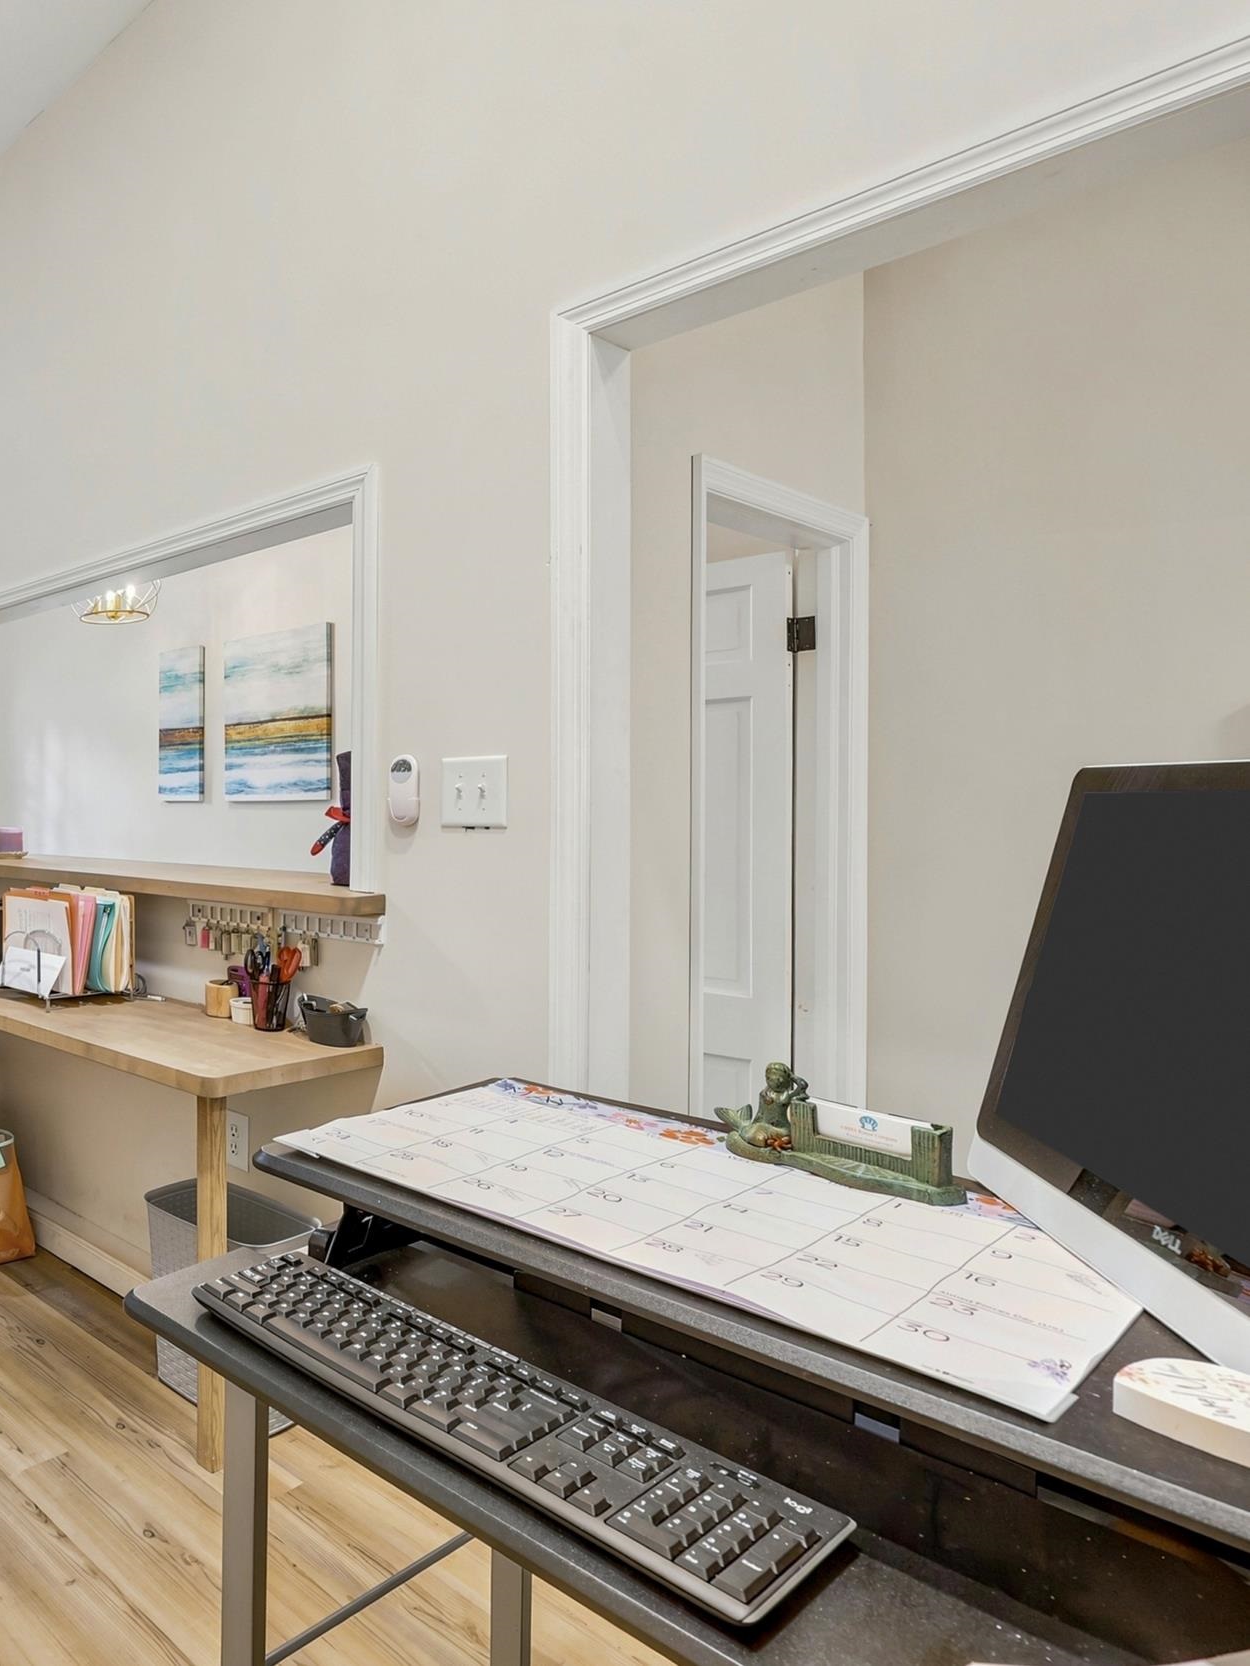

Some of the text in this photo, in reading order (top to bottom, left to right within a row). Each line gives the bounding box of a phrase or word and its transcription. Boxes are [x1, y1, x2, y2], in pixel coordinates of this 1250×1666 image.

[586, 1187, 623, 1203] 20
[1151, 1224, 1183, 1256] DELL
[760, 1270, 804, 1288] 29
[964, 1272, 998, 1287] 16
[929, 1296, 980, 1317] 23
[897, 1318, 950, 1342] 30
[783, 1496, 814, 1515] logi
